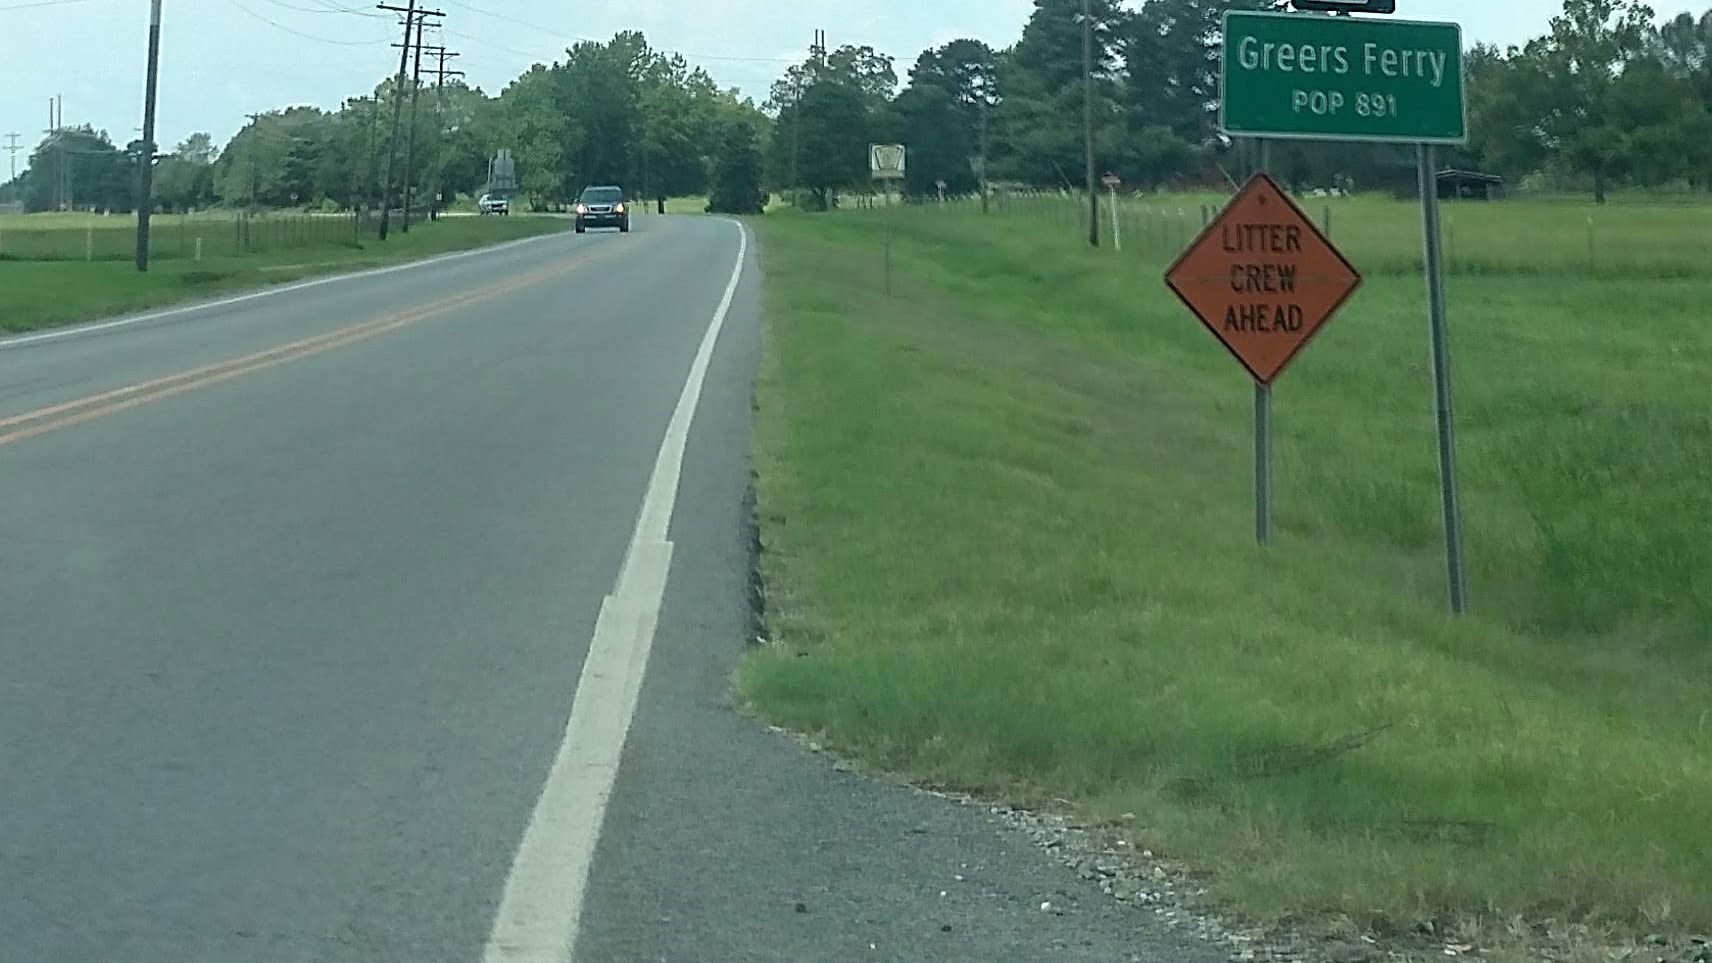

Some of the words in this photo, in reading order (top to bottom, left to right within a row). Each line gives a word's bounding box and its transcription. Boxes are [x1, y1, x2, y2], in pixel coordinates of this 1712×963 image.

[1239, 35, 1349, 75] Greers
[1363, 42, 1447, 87] Ferry
[1292, 89, 1345, 116] POP
[1354, 90, 1397, 118] 891
[1222, 222, 1302, 253] LITTER
[1230, 263, 1296, 293] CREW
[1223, 303, 1304, 333] AHEAD
